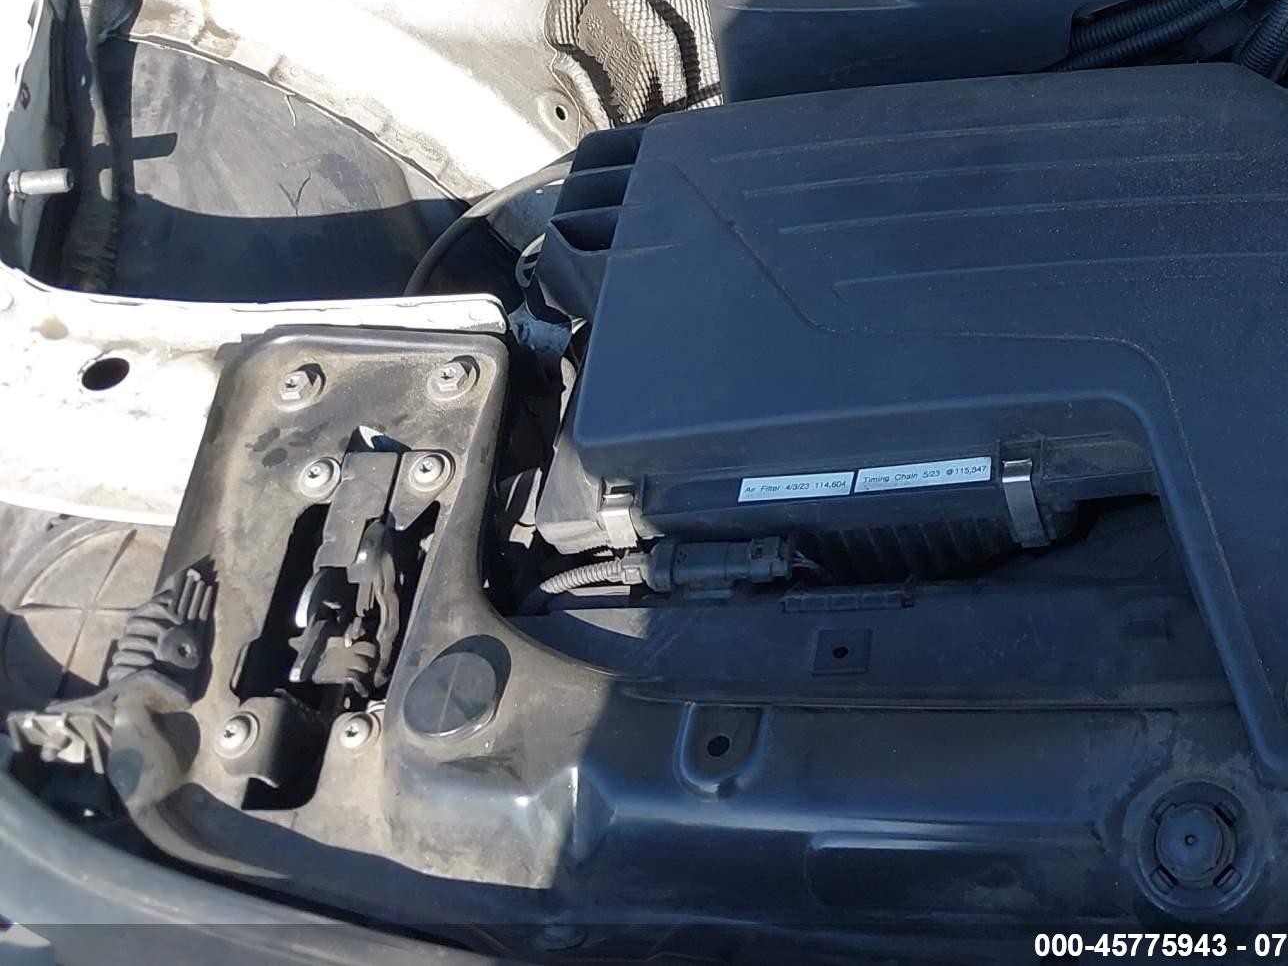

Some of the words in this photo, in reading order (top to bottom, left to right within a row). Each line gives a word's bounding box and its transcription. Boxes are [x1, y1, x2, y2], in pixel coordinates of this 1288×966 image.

[863, 475, 890, 484] Timing
[894, 473, 918, 481] Chain
[785, 482, 810, 491] 4/3/23
[815, 480, 847, 489] 114,604
